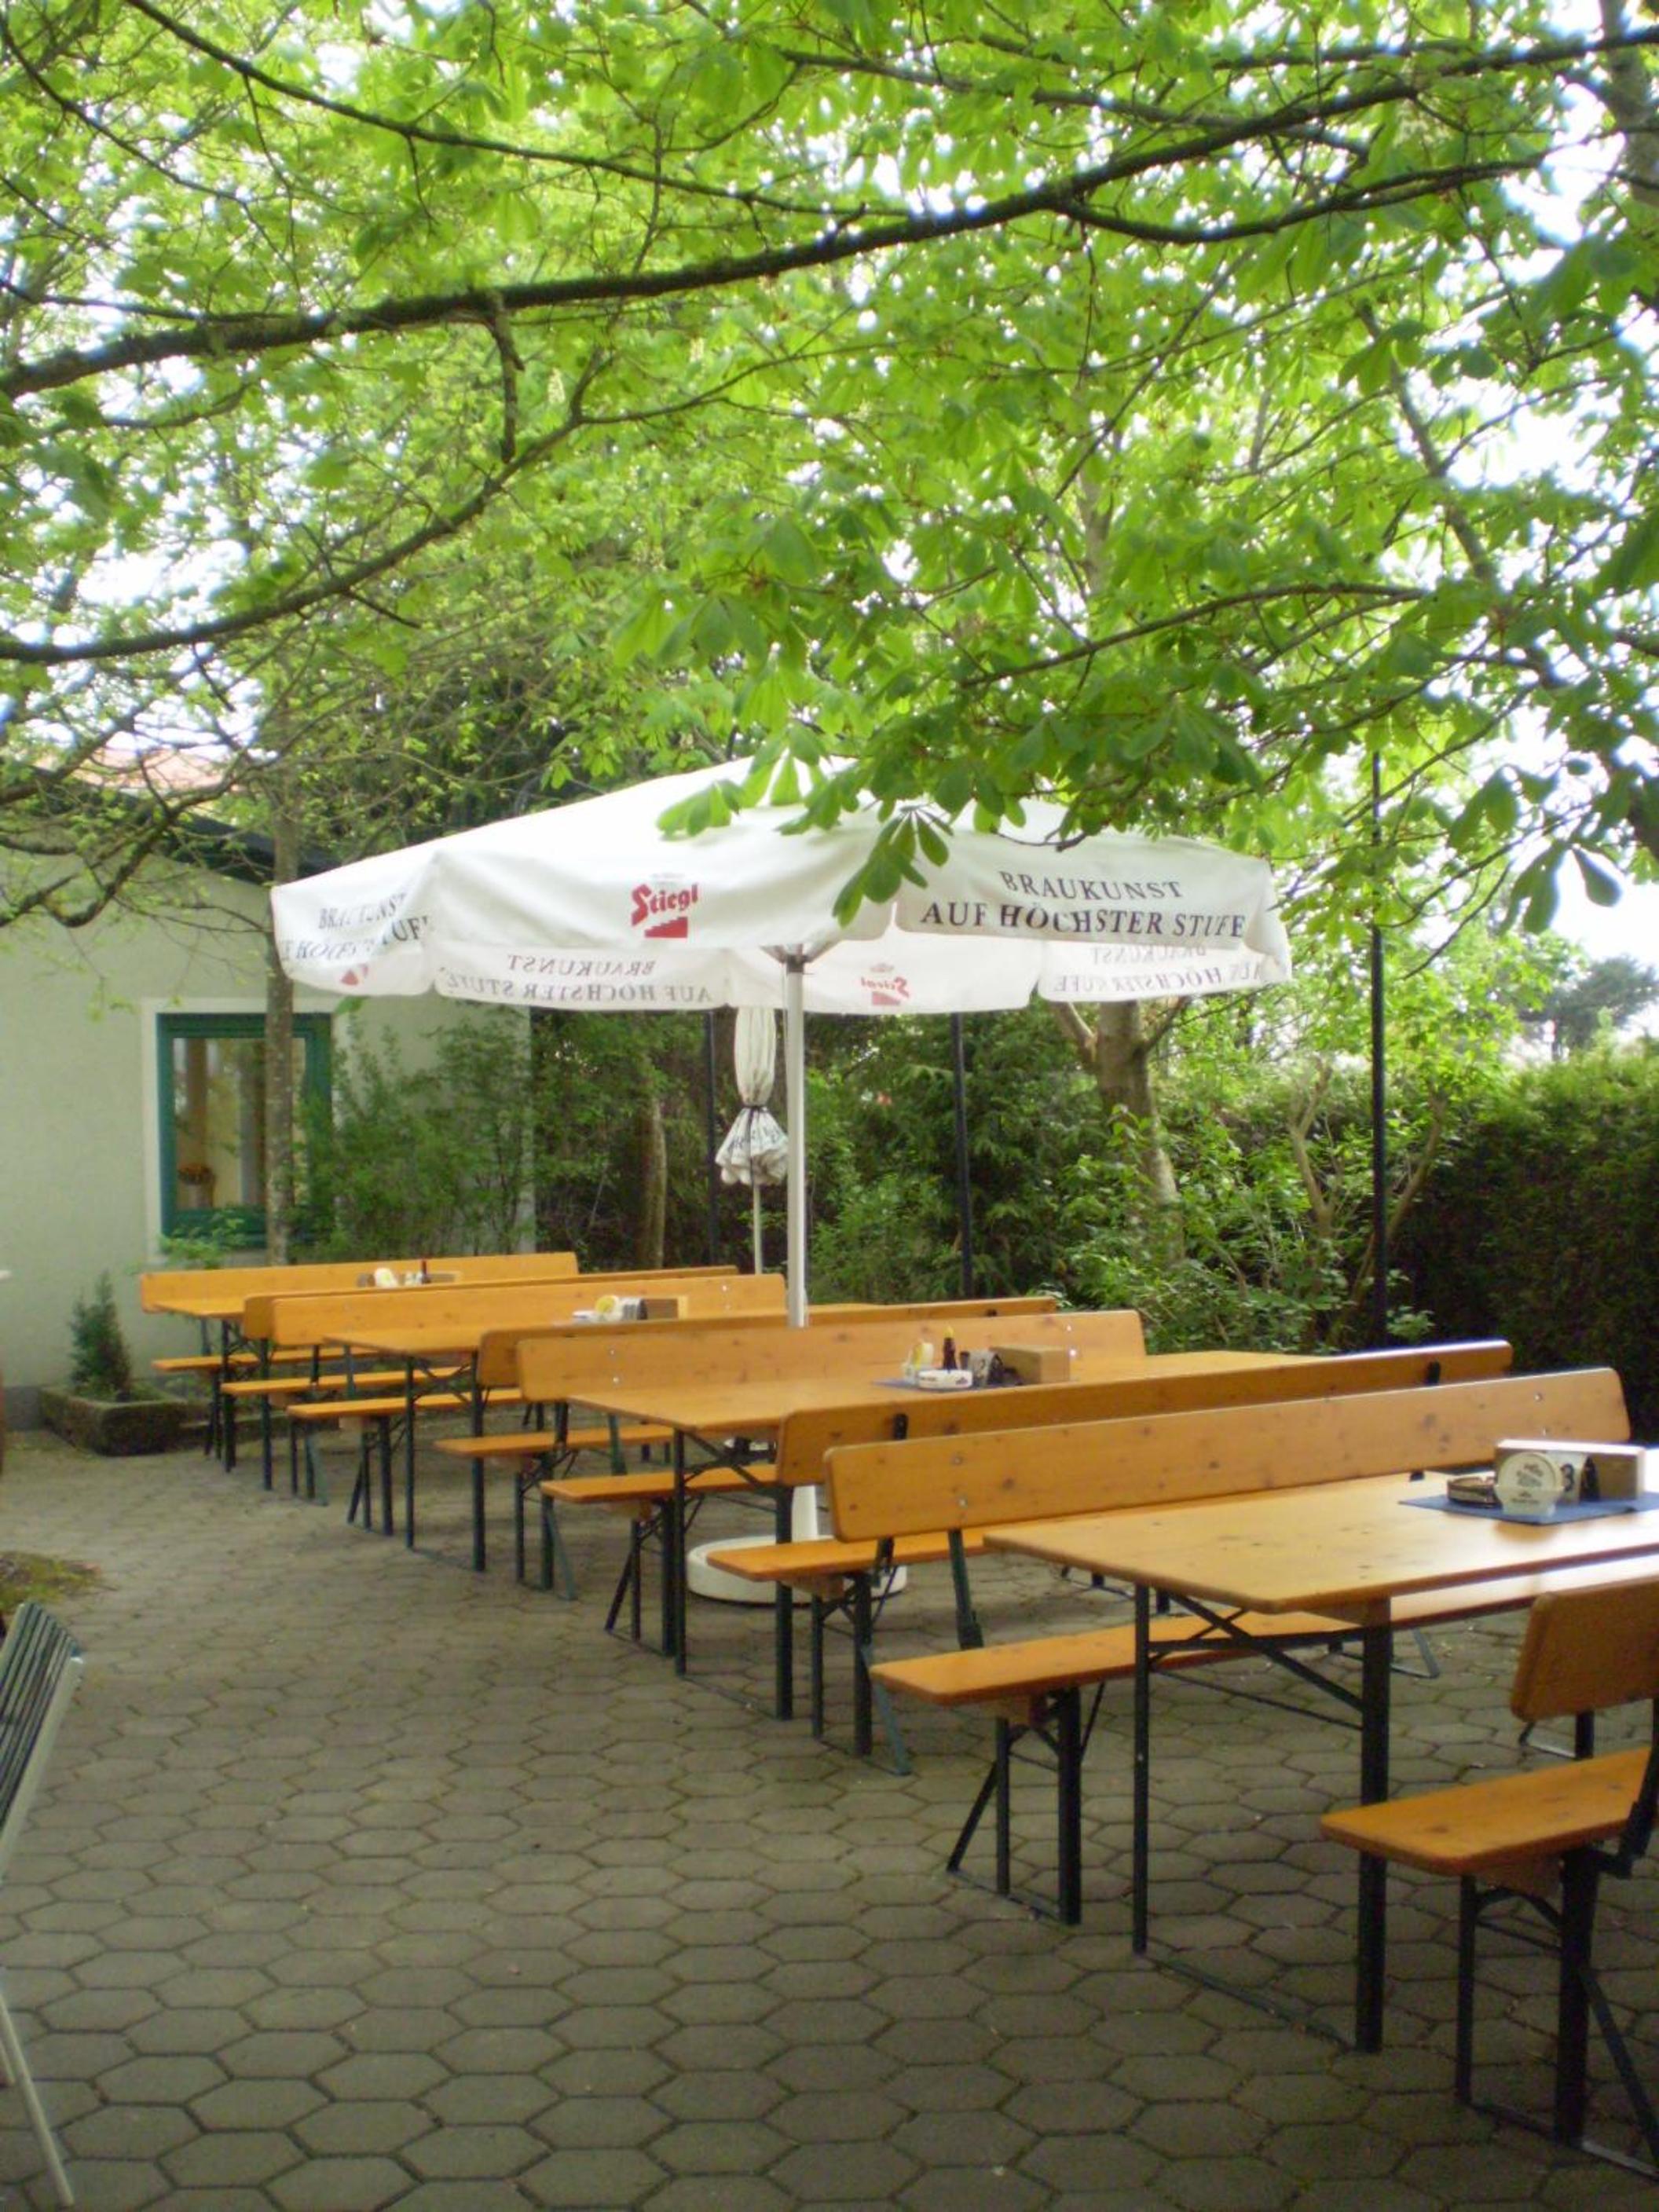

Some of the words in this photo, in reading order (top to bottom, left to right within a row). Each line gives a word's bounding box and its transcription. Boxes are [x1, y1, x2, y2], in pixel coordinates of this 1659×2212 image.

[998, 870, 1182, 901] BRAUKUNST
[631, 883, 698, 926] Stiegl
[920, 903, 987, 927] AUF
[1000, 903, 1163, 934] HÖCHSTER
